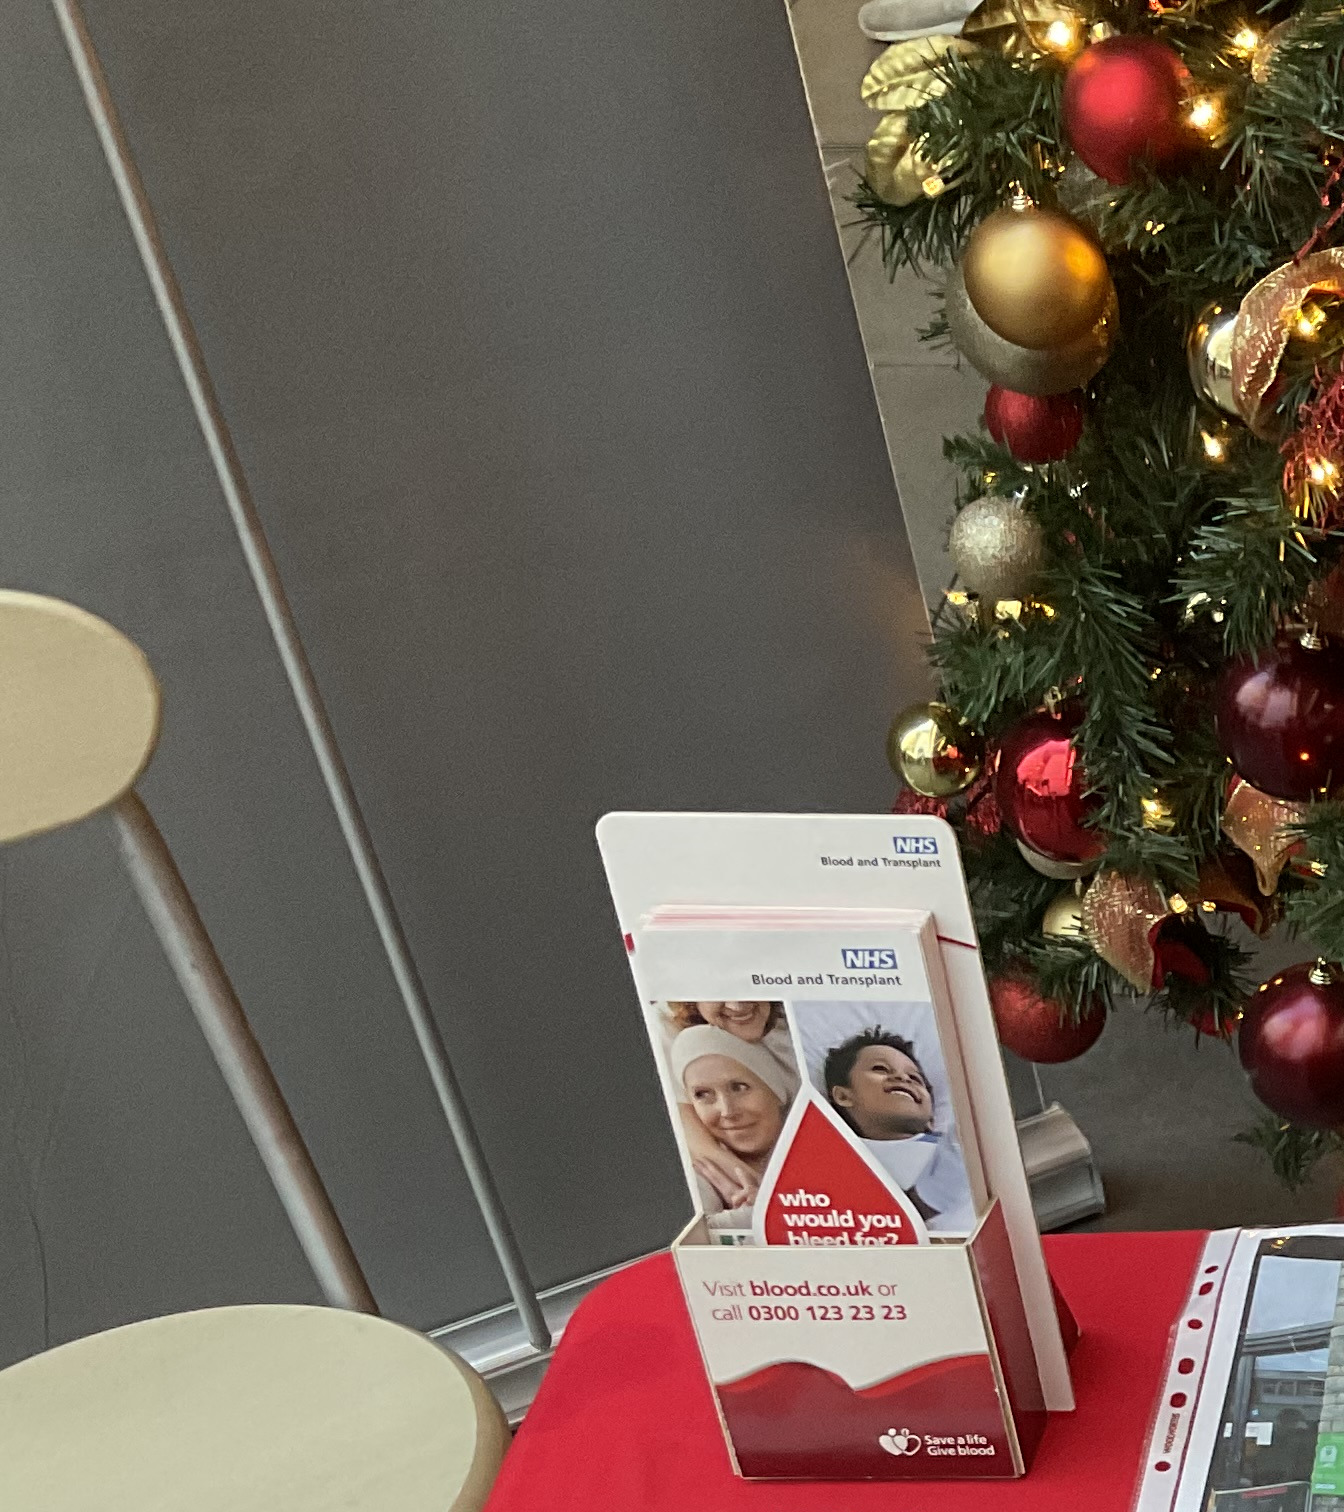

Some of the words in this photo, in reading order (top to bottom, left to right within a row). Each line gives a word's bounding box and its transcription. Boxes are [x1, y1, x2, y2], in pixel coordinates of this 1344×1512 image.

[845, 950, 897, 968] NHS
[751, 973, 792, 984] Blood
[797, 973, 823, 984] and
[826, 973, 901, 987] Transplant
[702, 1281, 745, 1296] Visit
[749, 1280, 873, 1296] blood.co.uk
[877, 1284, 896, 1296] or
[712, 1305, 742, 1320] call
[748, 1305, 799, 1320] 0300
[805, 1305, 843, 1320] 123
[848, 1305, 875, 1320] 23
[880, 1304, 906, 1320] 23
